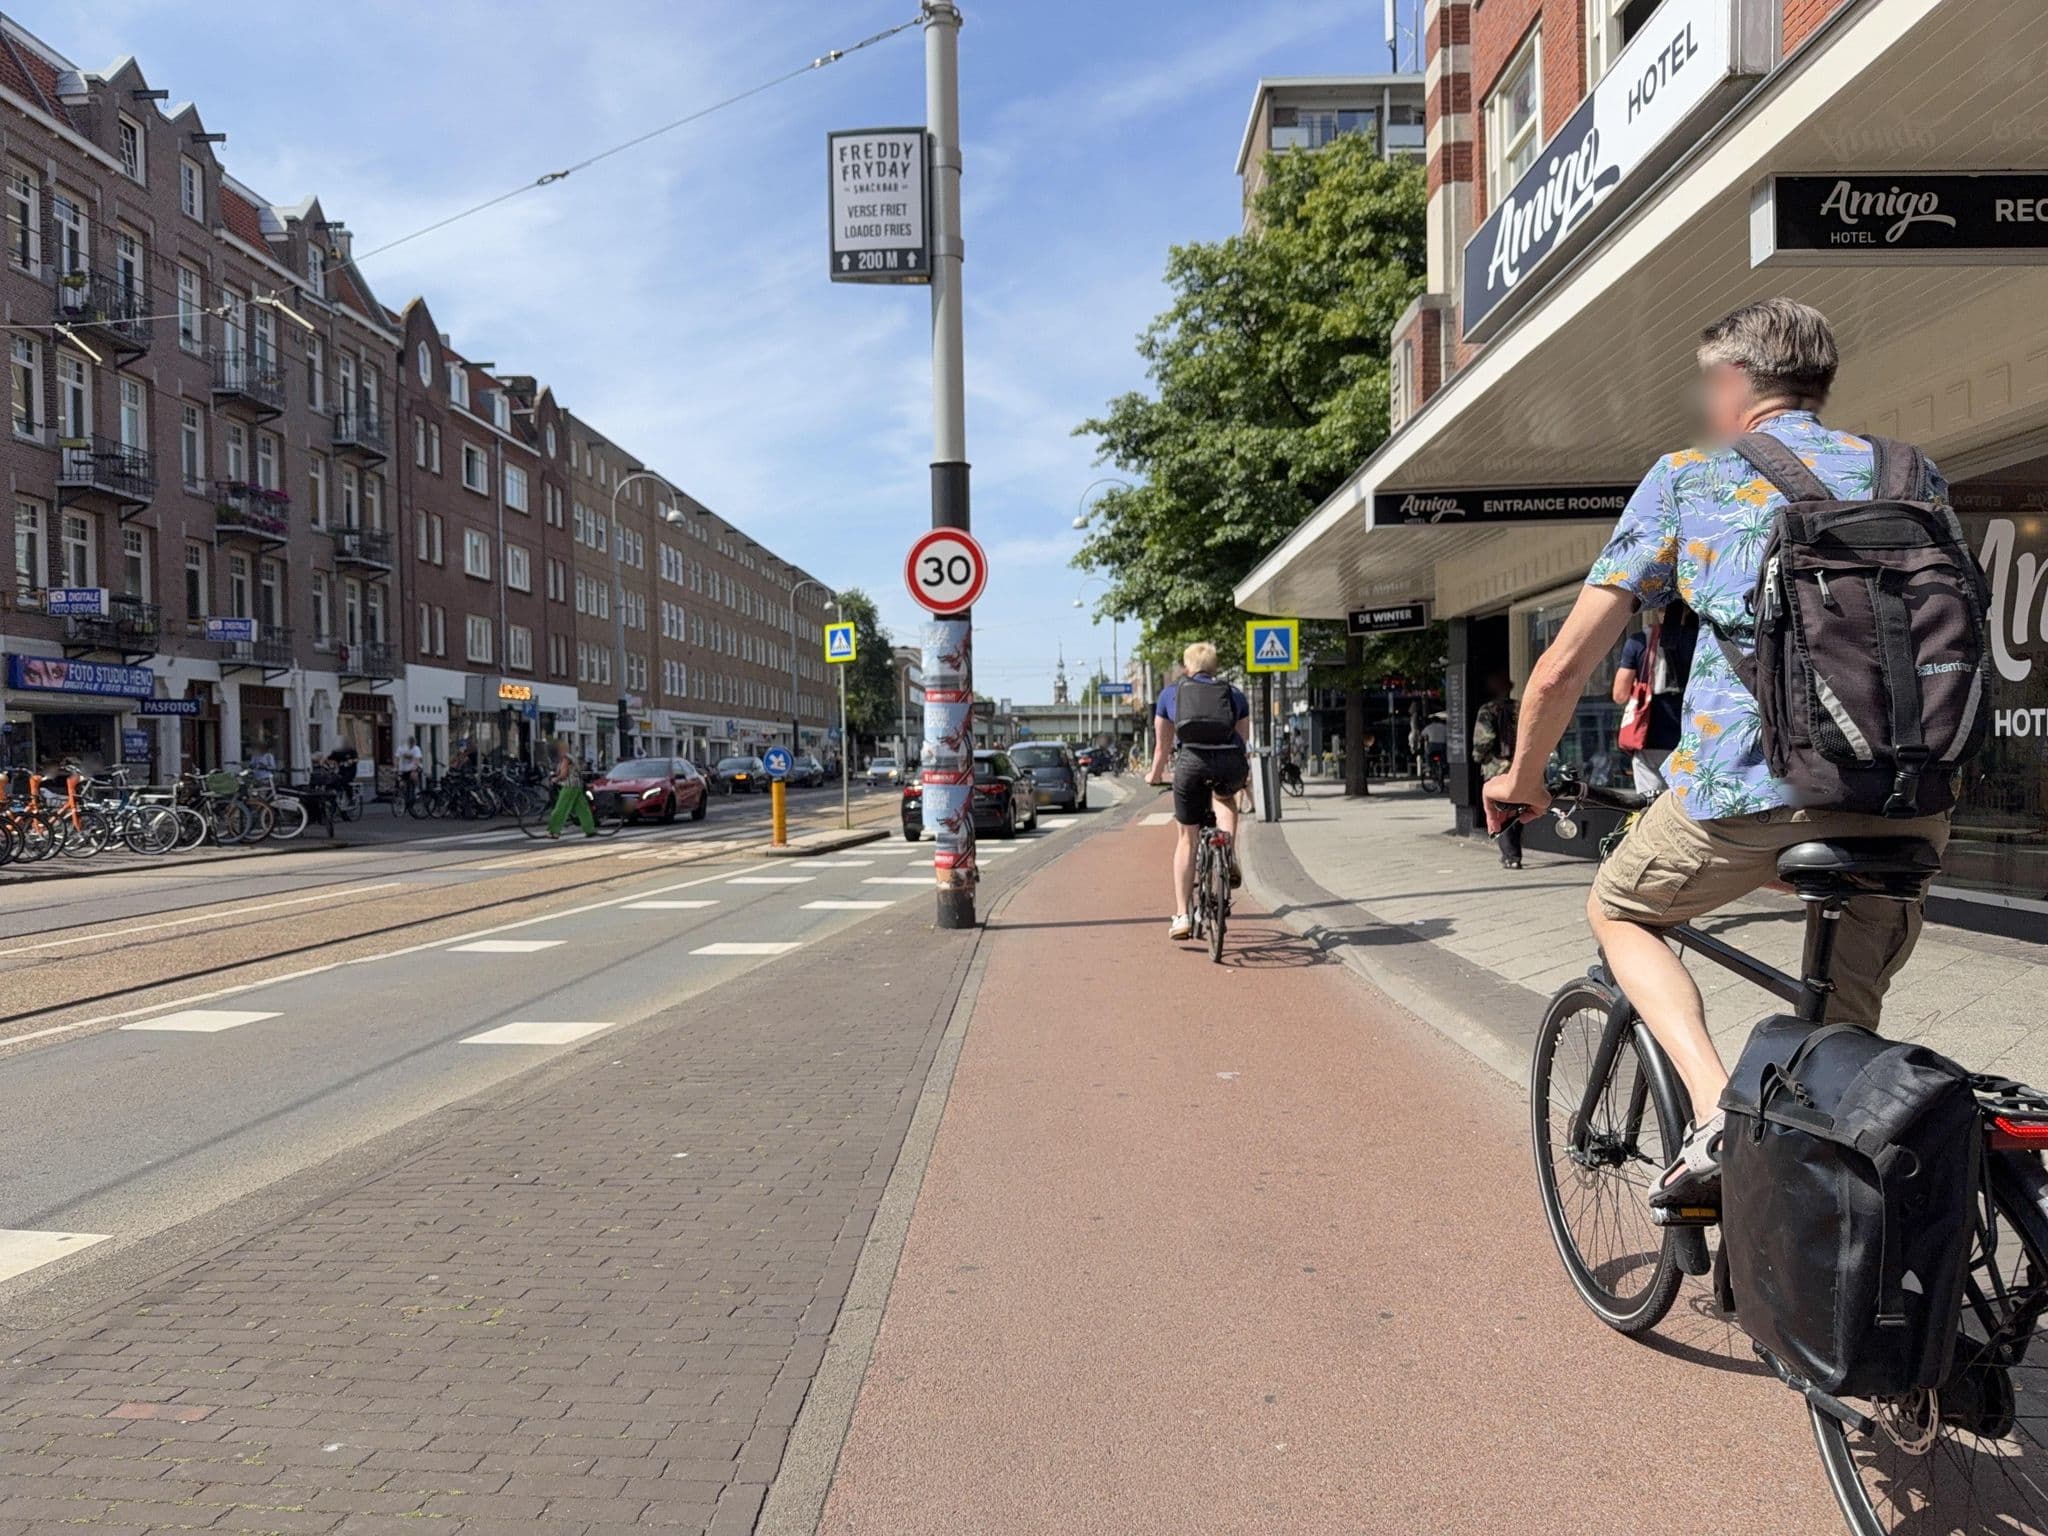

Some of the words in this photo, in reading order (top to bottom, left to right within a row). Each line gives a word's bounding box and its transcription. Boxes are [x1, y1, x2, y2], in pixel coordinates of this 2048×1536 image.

[1628, 21, 1698, 125] HOTEL
[839, 142, 914, 163] FREDDY
[842, 161, 911, 182] FRYDAY
[847, 204, 878, 218] VERSE
[880, 203, 907, 217] FRIET
[1487, 127, 1620, 291] Amigo
[1820, 180, 1956, 243] Amigo
[845, 224, 882, 239] LOADED
[884, 223, 912, 237] FRIES
[1831, 232, 1876, 244] HOTEL
[858, 251, 883, 270] 200
[886, 251, 898, 268] M
[1400, 495, 1465, 524] Amigo
[1483, 497, 1565, 513] ENTRANCE
[1568, 496, 1625, 511] ROOMS
[922, 555, 971, 586] 30
[68, 591, 100, 602] DIGITALE
[51, 603, 70, 614] FOTO
[1358, 613, 1371, 624] DE
[1373, 609, 1412, 622] WINTER
[69, 664, 94, 682] FOTO
[96, 666, 129, 684] STUDIO
[144, 701, 197, 712] PASFOTOS
[1995, 708, 2048, 737] HOT
